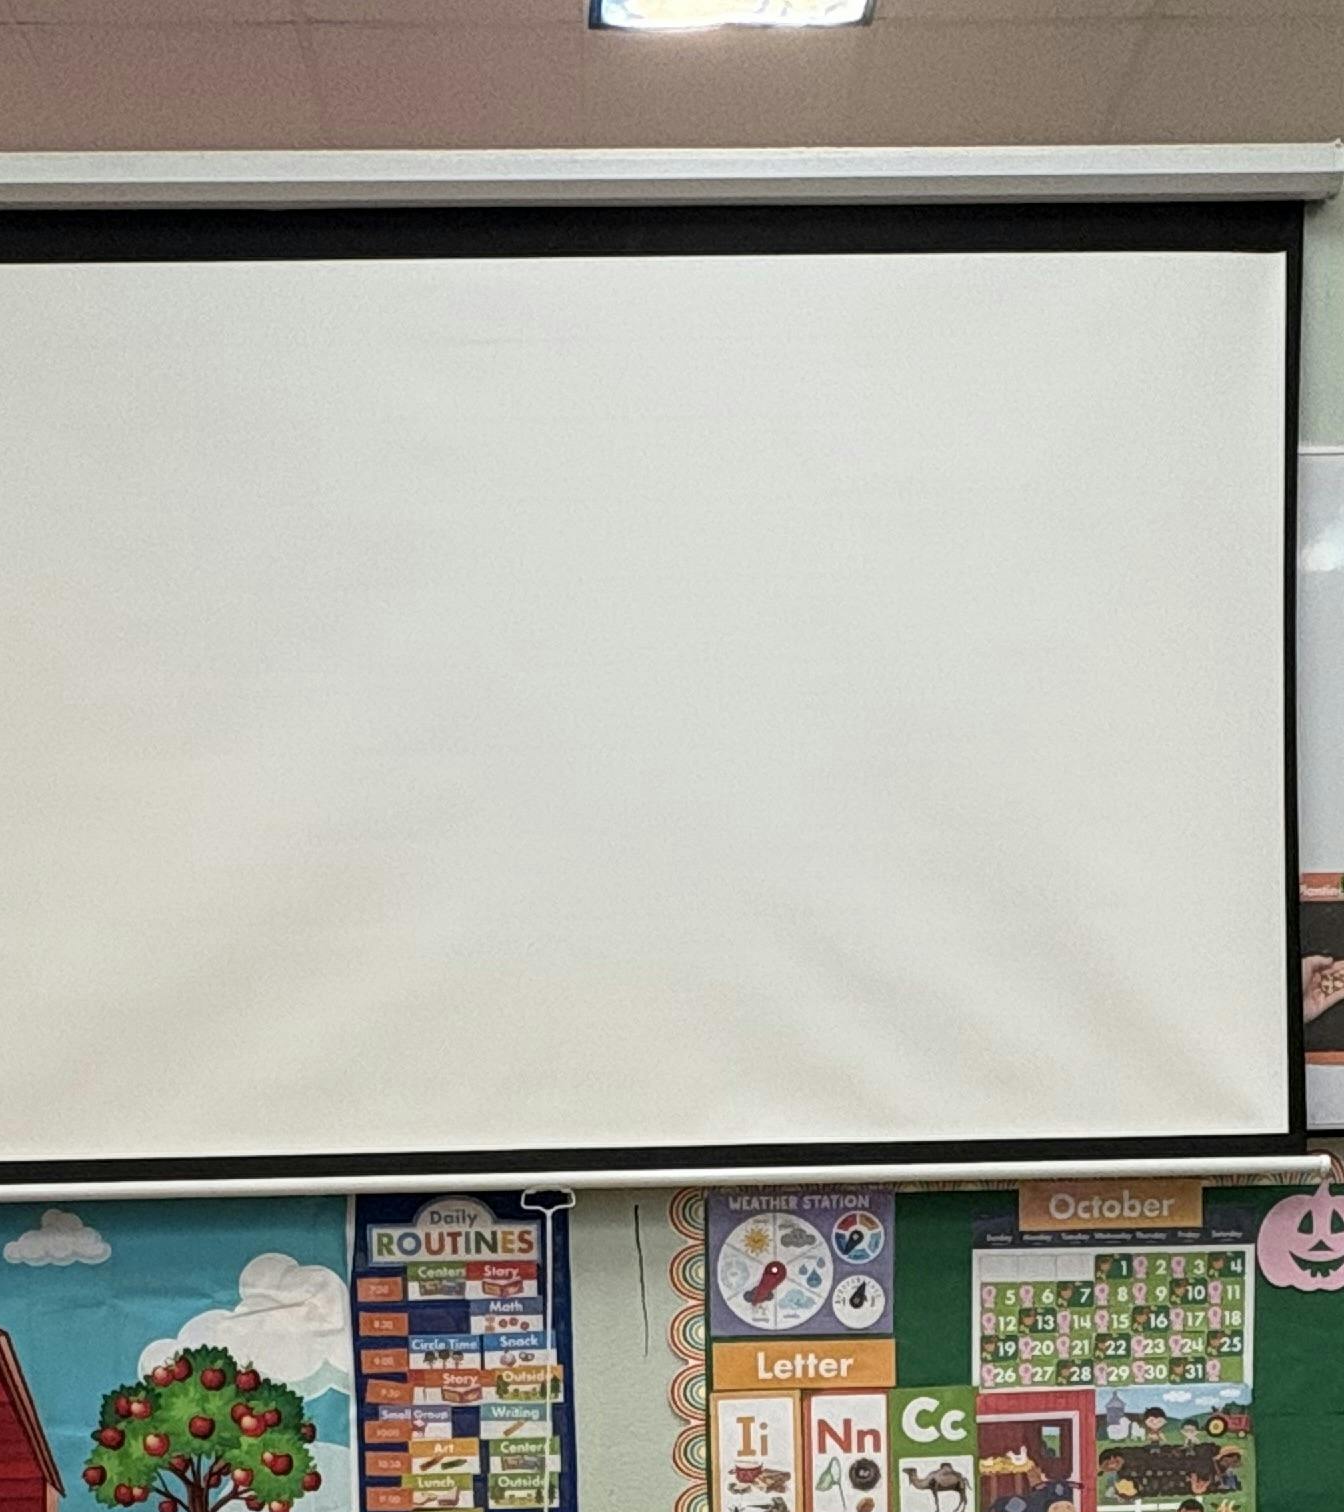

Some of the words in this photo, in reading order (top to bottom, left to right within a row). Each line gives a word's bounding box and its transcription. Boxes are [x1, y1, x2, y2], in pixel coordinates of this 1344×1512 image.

[728, 1195, 798, 1210] WEATHER
[802, 1193, 870, 1209] STATION
[1049, 1190, 1175, 1220] October
[429, 1209, 478, 1228] Daily
[376, 1230, 534, 1257] ROUTINES
[483, 1264, 520, 1280] Story
[1120, 1261, 1128, 1276] 1
[1155, 1260, 1167, 1275] 2
[1193, 1259, 1205, 1275] 3
[1230, 1259, 1242, 1274] 4
[1005, 1289, 1016, 1305] 5
[1042, 1287, 1054, 1303] 6
[1080, 1288, 1091, 1303] 7
[1117, 1287, 1128, 1302] 8
[1156, 1286, 1168, 1301] 9
[1187, 1285, 1205, 1300] 10
[1226, 1285, 1241, 1299] 11
[488, 1300, 523, 1313] Math
[998, 1316, 1016, 1331] 12
[1036, 1315, 1054, 1330] 13
[1073, 1315, 1092, 1329] 14
[1111, 1314, 1129, 1328] 15
[1149, 1313, 1168, 1328] 16
[1186, 1311, 1205, 1326] 17
[1224, 1311, 1242, 1326] 18
[412, 1338, 446, 1351] Circle
[449, 1338, 477, 1350] Time
[500, 1335, 539, 1347] Snack
[998, 1341, 1016, 1356] 19
[1031, 1340, 1054, 1355] 20
[1072, 1340, 1090, 1355] 21
[1105, 1339, 1127, 1354] 22
[1143, 1338, 1166, 1353] 23
[1181, 1337, 1204, 1352] 24
[1219, 1337, 1242, 1352] 25
[757, 1350, 854, 1381] Letter
[994, 1367, 1016, 1382] 26
[1032, 1366, 1054, 1381] 27
[1069, 1365, 1092, 1381] 28
[1107, 1365, 1129, 1380] 29
[1144, 1364, 1168, 1380] 30
[1184, 1363, 1204, 1379] 31
[442, 1372, 479, 1387] Story
[491, 1406, 541, 1420] Writing
[901, 1396, 968, 1443] Cc
[736, 1415, 769, 1457] Ii
[817, 1418, 881, 1454] Nn
[433, 1442, 455, 1454] Art
[416, 1476, 456, 1489] Lunch
